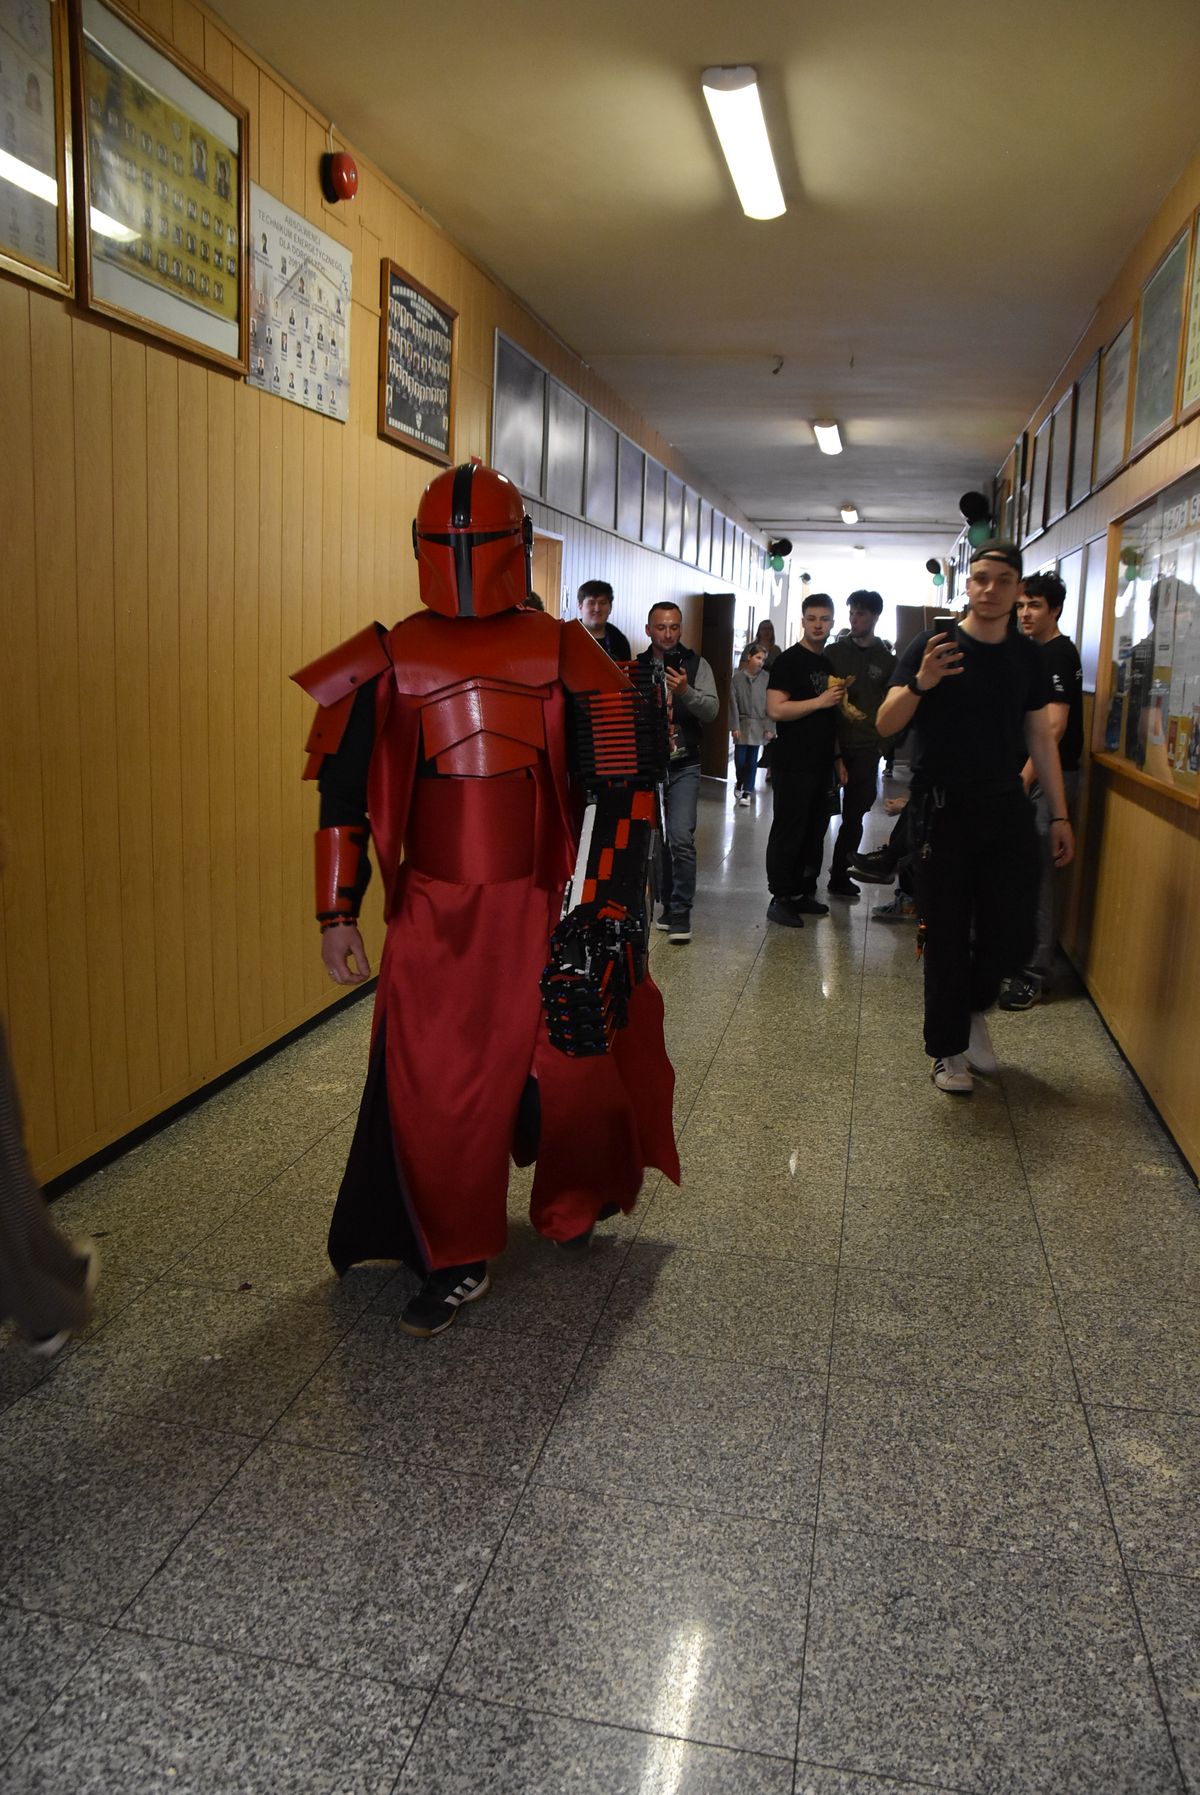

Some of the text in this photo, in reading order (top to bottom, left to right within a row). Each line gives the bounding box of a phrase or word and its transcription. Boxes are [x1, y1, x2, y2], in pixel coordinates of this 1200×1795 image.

[258, 209, 293, 240] TECHNIKUM
[293, 233, 343, 272] ENERGETYCZNEGO
[280, 237, 292, 254] DLA
